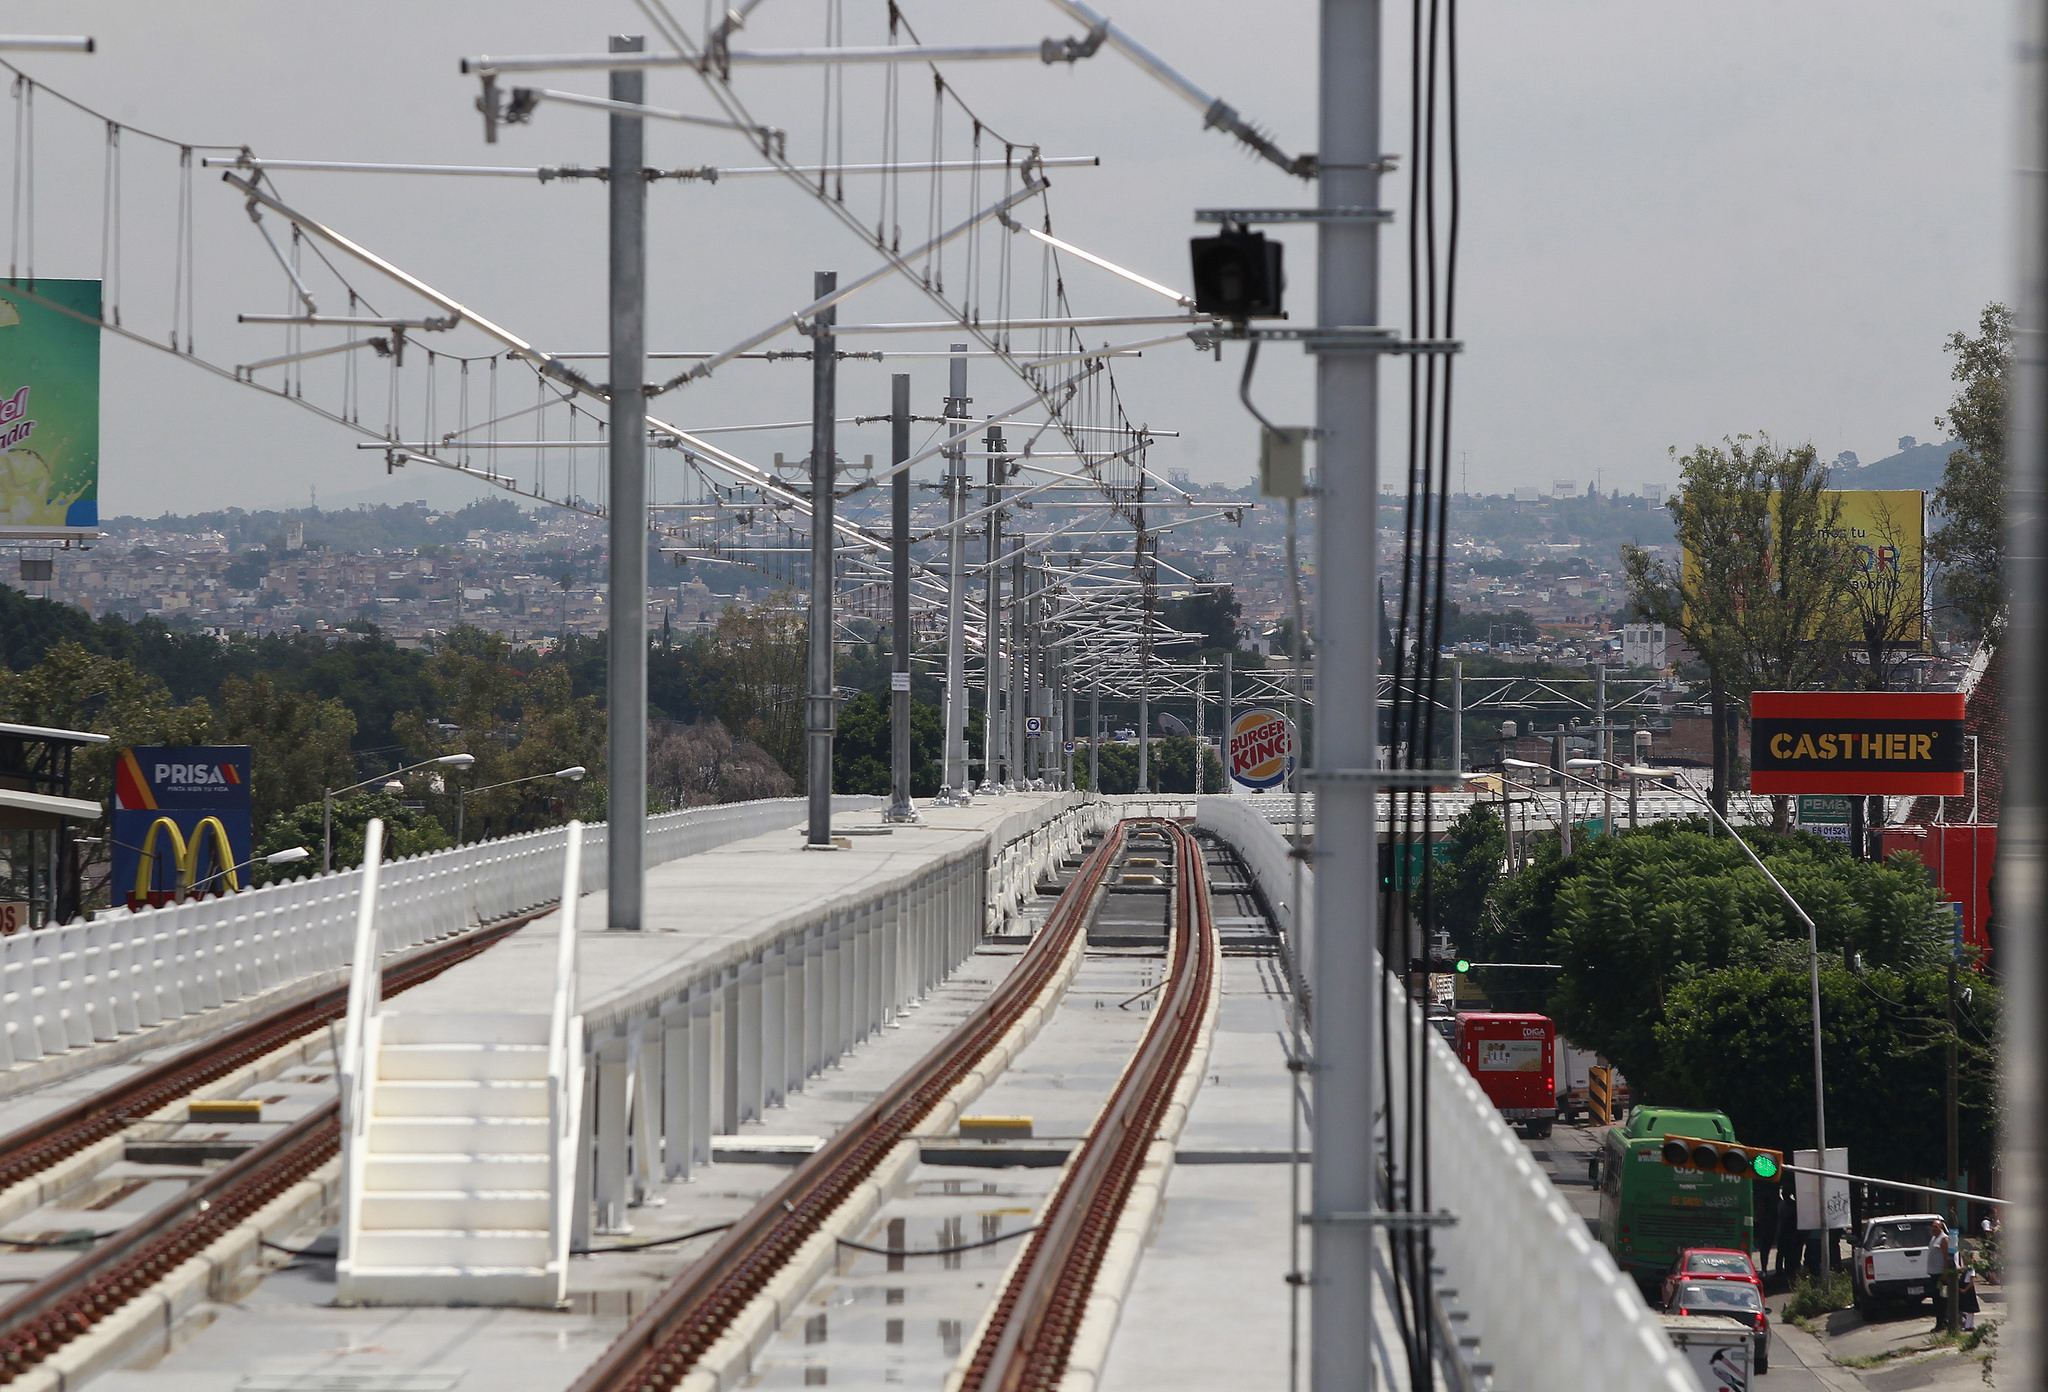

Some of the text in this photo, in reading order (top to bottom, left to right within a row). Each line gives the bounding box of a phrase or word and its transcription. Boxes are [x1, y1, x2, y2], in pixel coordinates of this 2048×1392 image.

[1851, 527, 1865, 538] tu
[1230, 720, 1285, 755] BURGER
[1769, 732, 1933, 760] CASTHER
[1233, 733, 1292, 776] KING
[154, 763, 226, 784] PRISA
